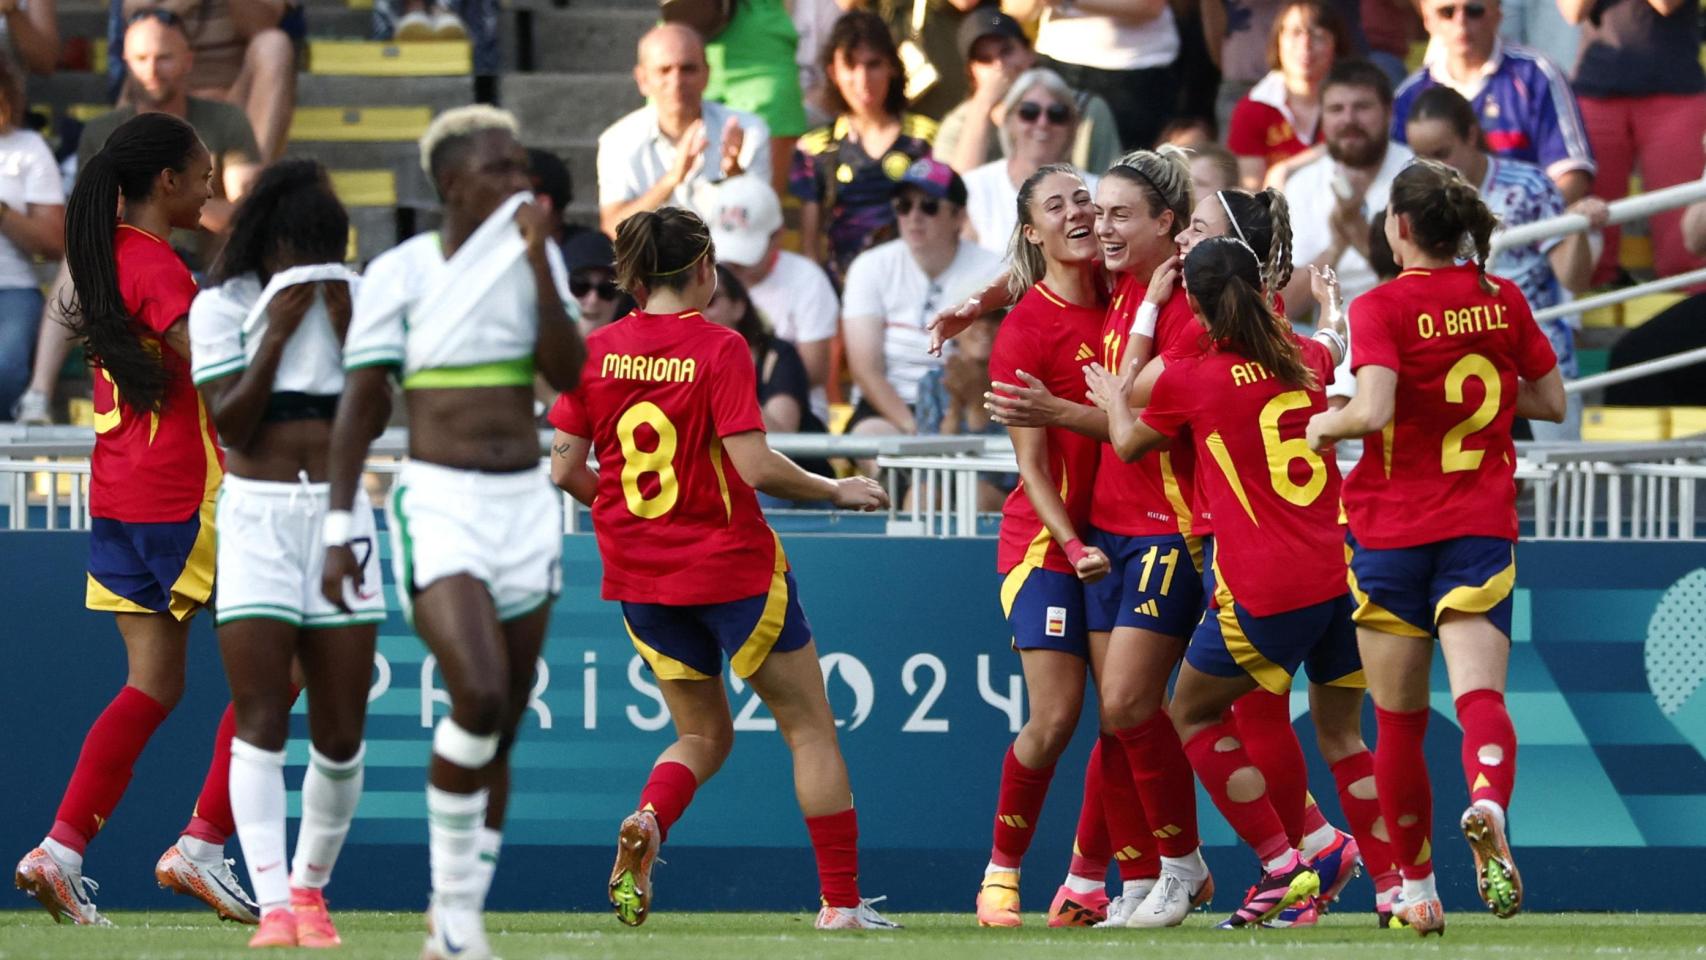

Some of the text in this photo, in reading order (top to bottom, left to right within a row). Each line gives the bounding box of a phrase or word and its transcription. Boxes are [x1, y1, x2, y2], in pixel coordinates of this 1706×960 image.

[1103, 329, 1121, 376] 11
[1417, 304, 1509, 339] O. BATLL
[601, 353, 696, 382] MARIONA
[1441, 353, 1501, 474] 2
[617, 401, 679, 518] 8
[1259, 390, 1328, 507] 6
[1137, 545, 1180, 597] 11
[729, 652, 1022, 733] 2024
